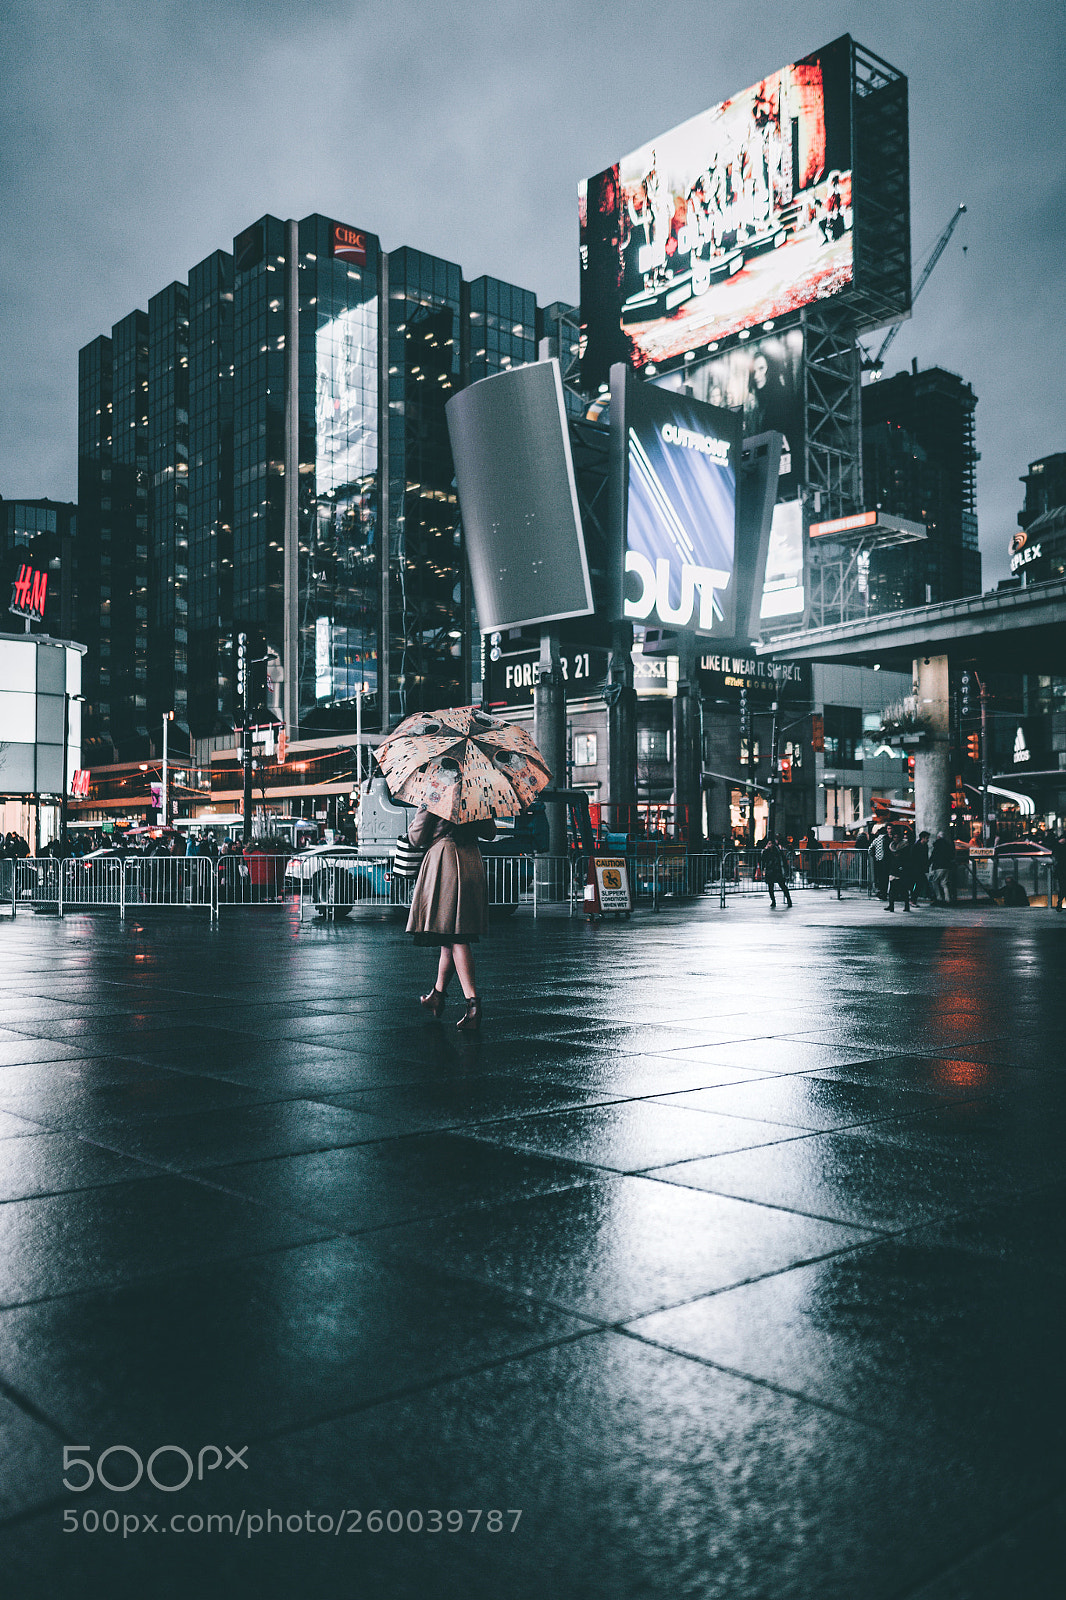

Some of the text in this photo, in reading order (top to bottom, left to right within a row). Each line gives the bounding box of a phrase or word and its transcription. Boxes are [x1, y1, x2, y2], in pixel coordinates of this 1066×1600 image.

[335, 227, 365, 248] CIBC
[661, 423, 731, 459] OUTFRONT
[14, 564, 48, 616] H&M
[624, 550, 731, 630] OUT
[506, 653, 590, 689] FORER 21
[701, 655, 720, 672] LIKE
[732, 658, 756, 676] WEAR
[767, 662, 793, 680] SRE
